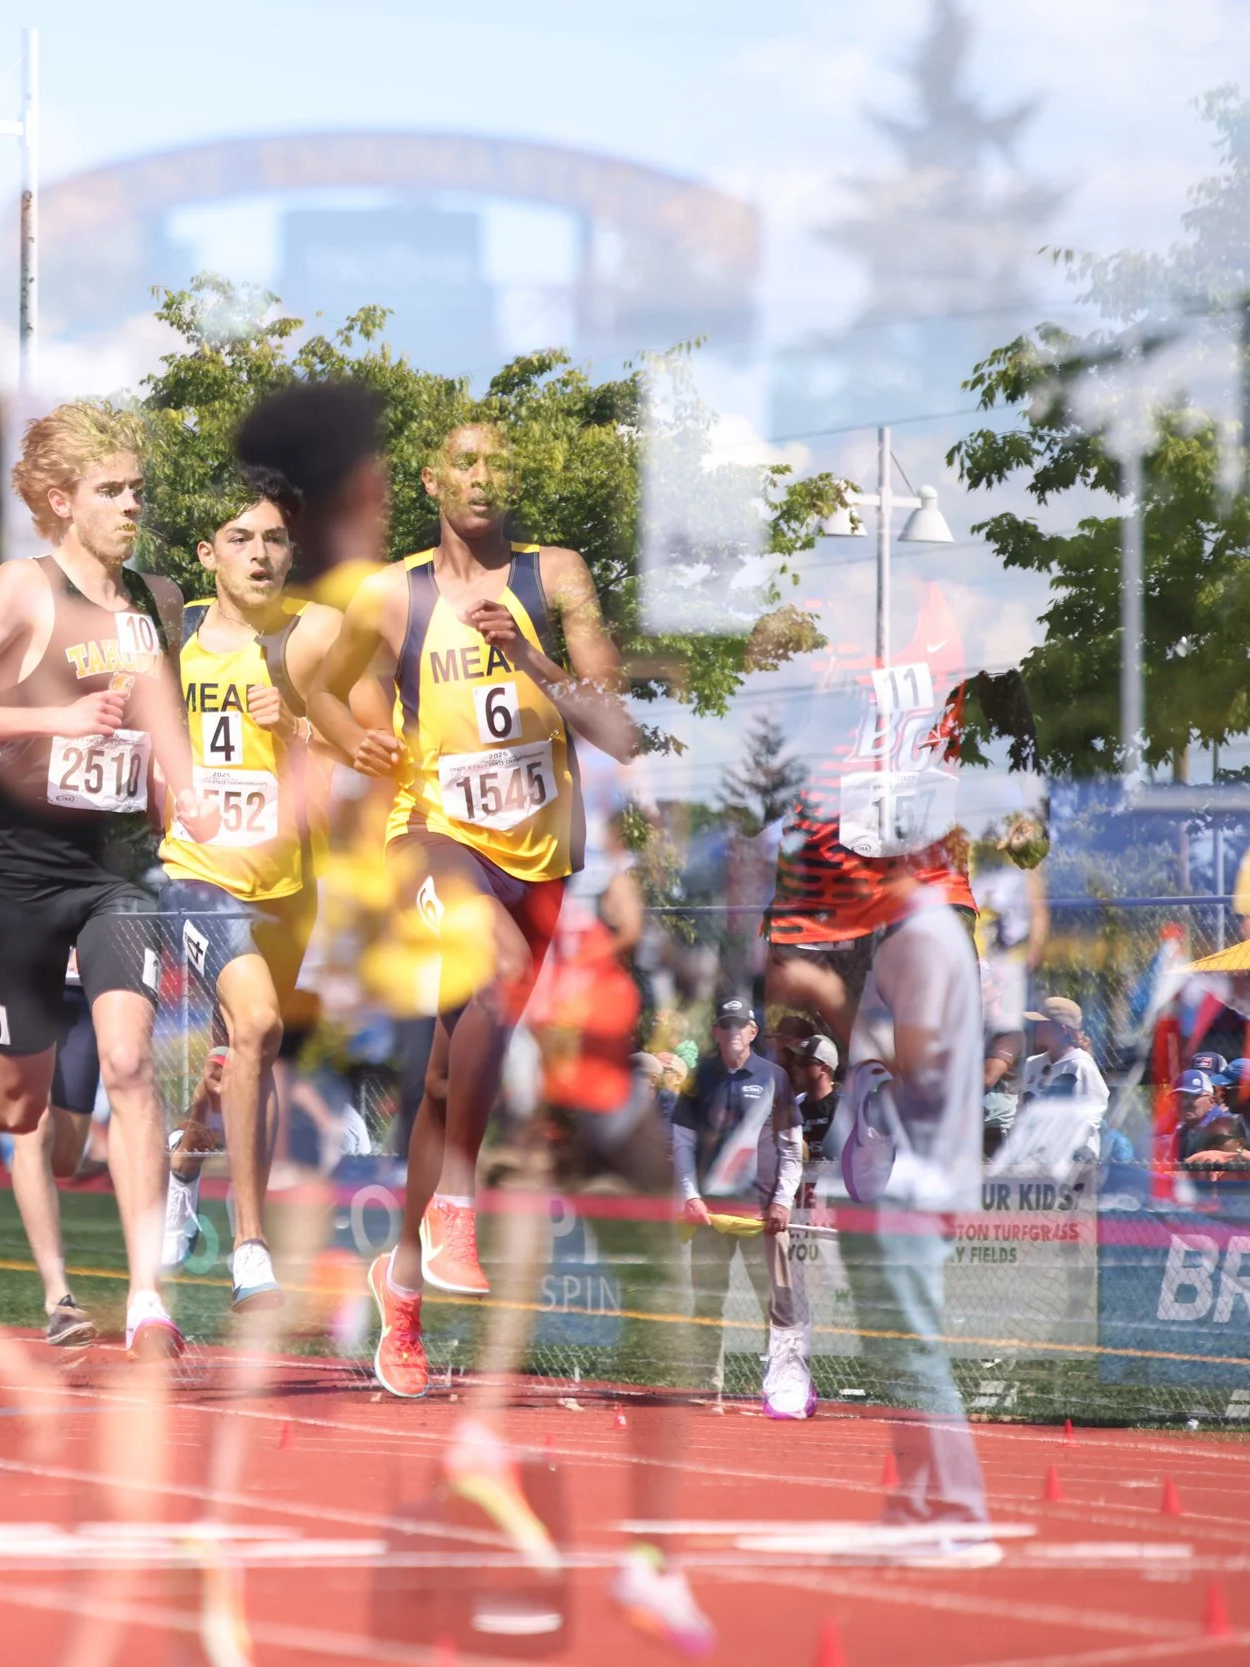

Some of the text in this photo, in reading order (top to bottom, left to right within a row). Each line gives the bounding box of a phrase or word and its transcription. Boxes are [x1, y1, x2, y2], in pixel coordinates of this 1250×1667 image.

[127, 616, 154, 653] 10
[430, 646, 517, 684] MEA
[886, 667, 920, 709] 11
[485, 687, 512, 739] 6
[210, 716, 235, 762] 4
[60, 747, 141, 798] 2510
[456, 762, 547, 819] 1545
[981, 1183, 1011, 1210] UR
[956, 1223, 1080, 1241] TON TURFGRASS
[970, 1247, 1017, 1263] FIELDS
[540, 1274, 621, 1314] SPIN
